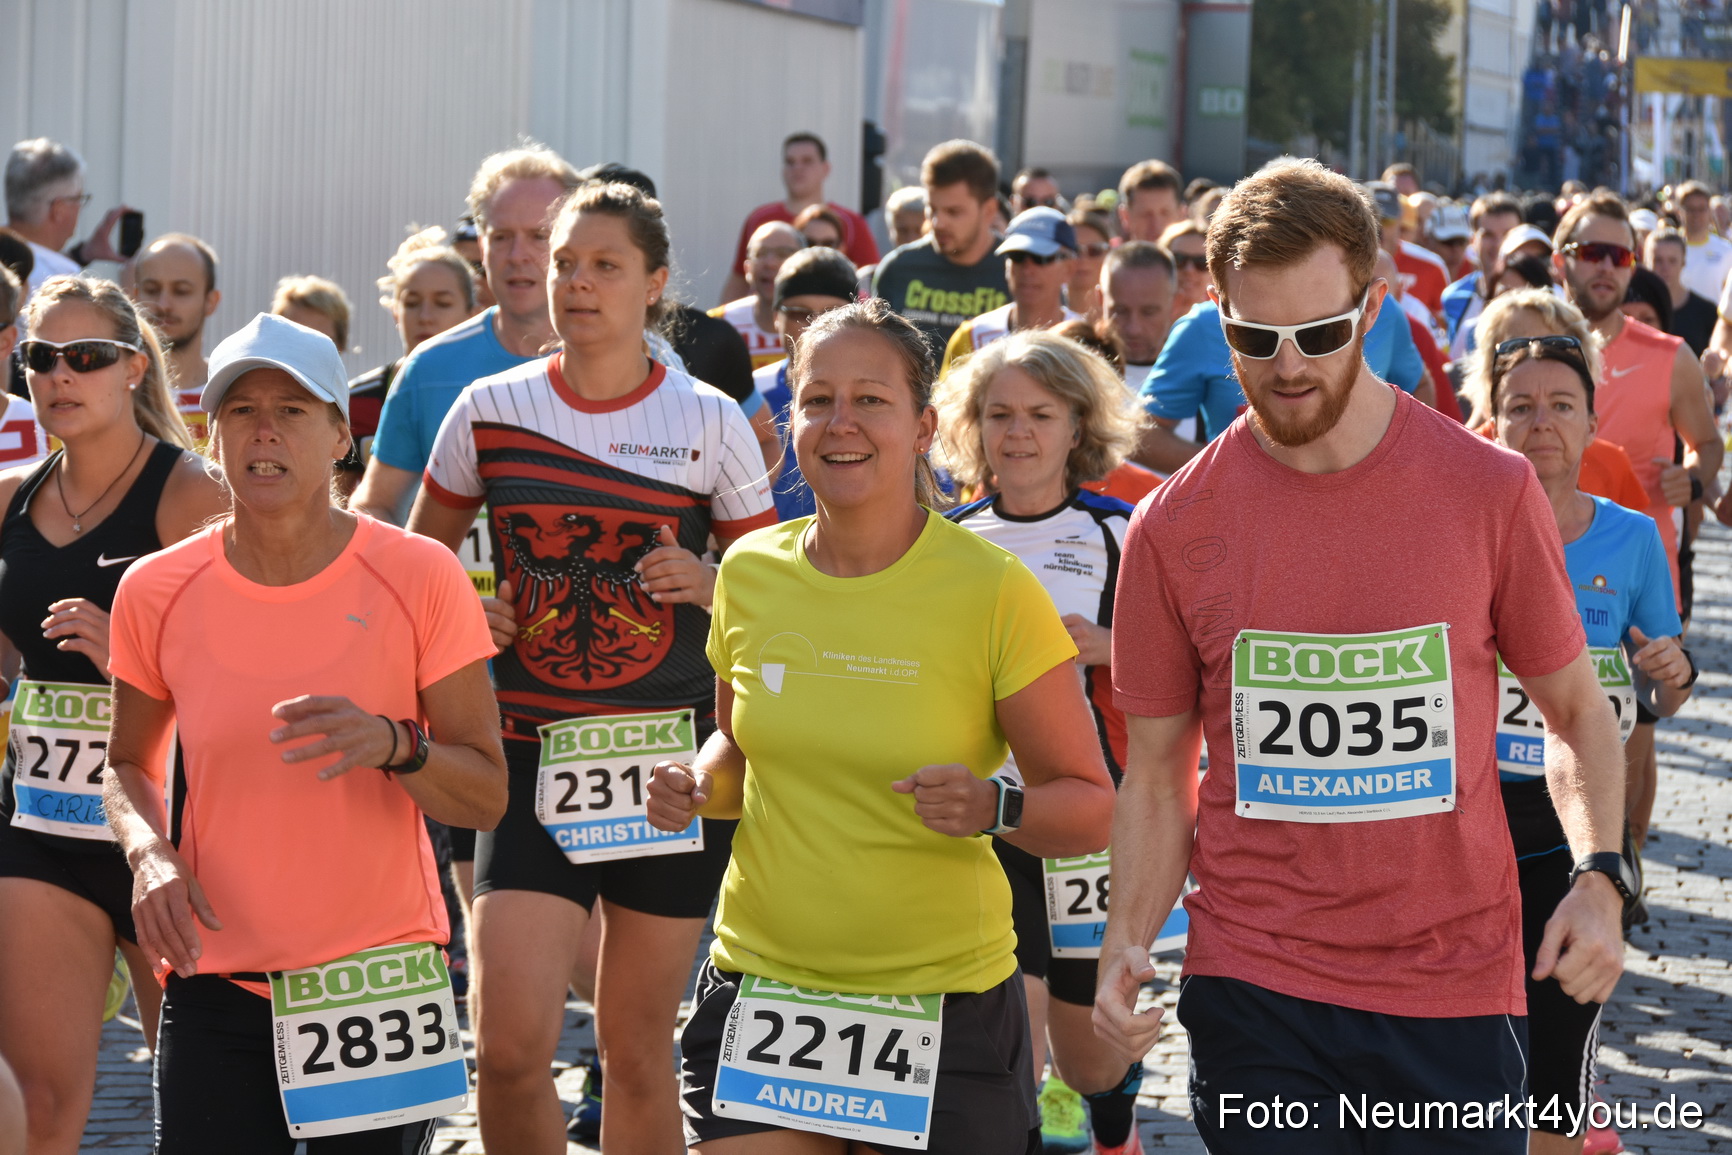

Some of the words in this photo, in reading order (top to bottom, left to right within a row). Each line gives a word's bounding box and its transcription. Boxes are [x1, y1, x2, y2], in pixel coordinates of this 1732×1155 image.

[608, 443, 689, 459] NEUMARKT
[1043, 562, 1082, 576] nürnberg
[1058, 558, 1093, 570] klinikum
[822, 650, 856, 662] Kliniken
[857, 654, 872, 664] des
[873, 655, 921, 668] Landkreises
[846, 663, 888, 676] Neumarkt
[1249, 635, 1434, 685] BOCK
[22, 688, 112, 725] BOC
[1433, 698, 1443, 708] C
[549, 717, 684, 761] BOCK
[1258, 696, 1428, 758] 2035
[26, 735, 109, 784] 272
[554, 765, 659, 814] 231
[1257, 768, 1433, 797] ALEXANDER
[285, 945, 443, 1008] BOCK
[298, 1003, 446, 1075] 2833
[747, 1009, 912, 1082] 2214
[920, 1036, 931, 1047] D
[756, 1084, 888, 1122] ANDREA
